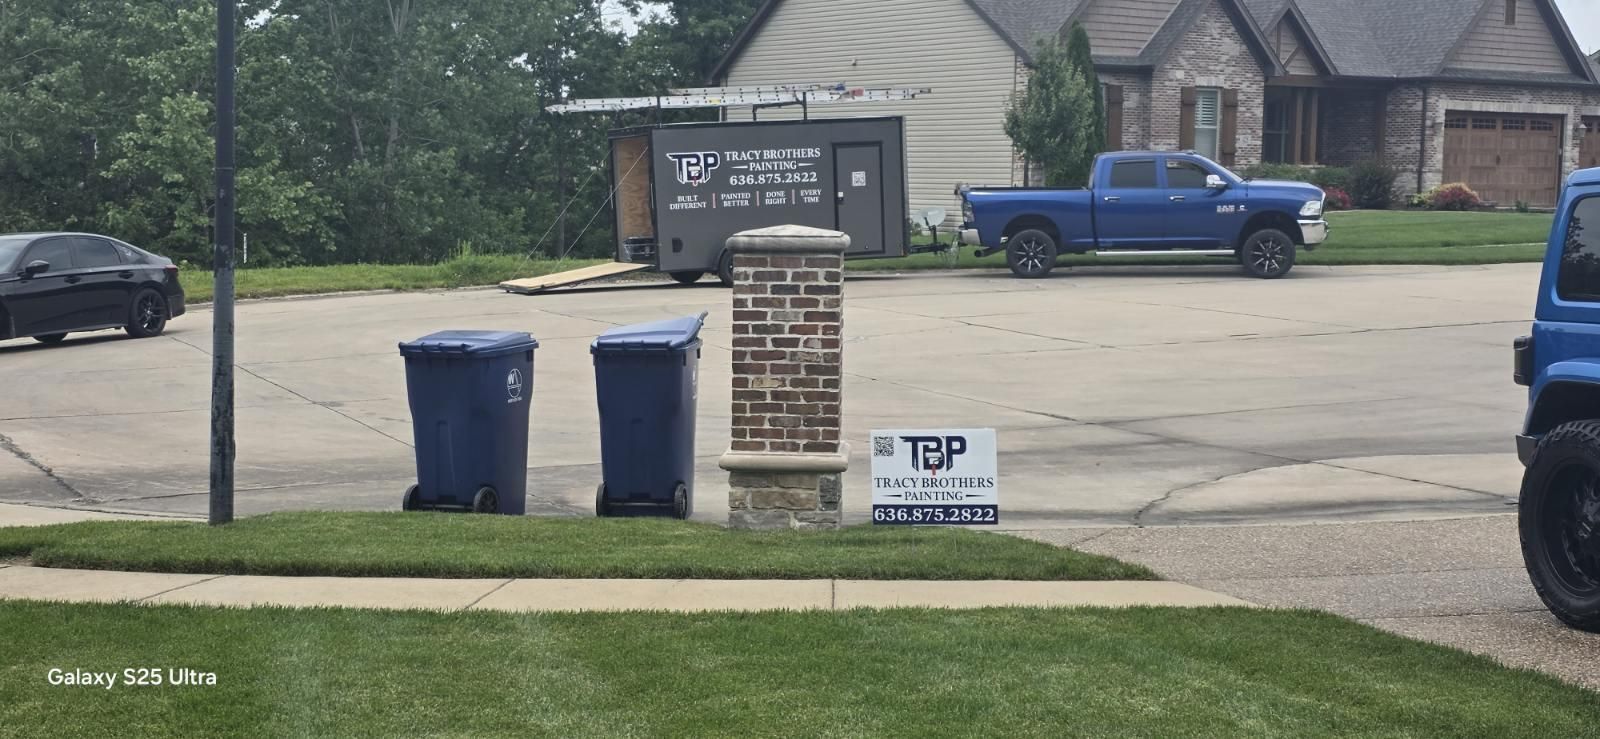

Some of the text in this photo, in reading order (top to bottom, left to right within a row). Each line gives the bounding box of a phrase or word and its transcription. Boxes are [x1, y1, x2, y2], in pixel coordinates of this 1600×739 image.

[724, 148, 821, 161] TRACY BROTHERS
[666, 151, 720, 186] TBP
[749, 161, 797, 171] PAINTING
[729, 172, 818, 186] 636.875.2822
[721, 192, 751, 200] PAINTED
[800, 189, 822, 197] EVERY
[669, 202, 707, 210] DIFFERENT
[723, 199, 750, 207] BETTER
[765, 197, 787, 205] RIGHT
[899, 435, 967, 473] TBP
[874, 477, 994, 489] TRACY BROTHERS
[905, 491, 964, 501] PAINTING
[874, 508, 995, 522] 636.875.2822
